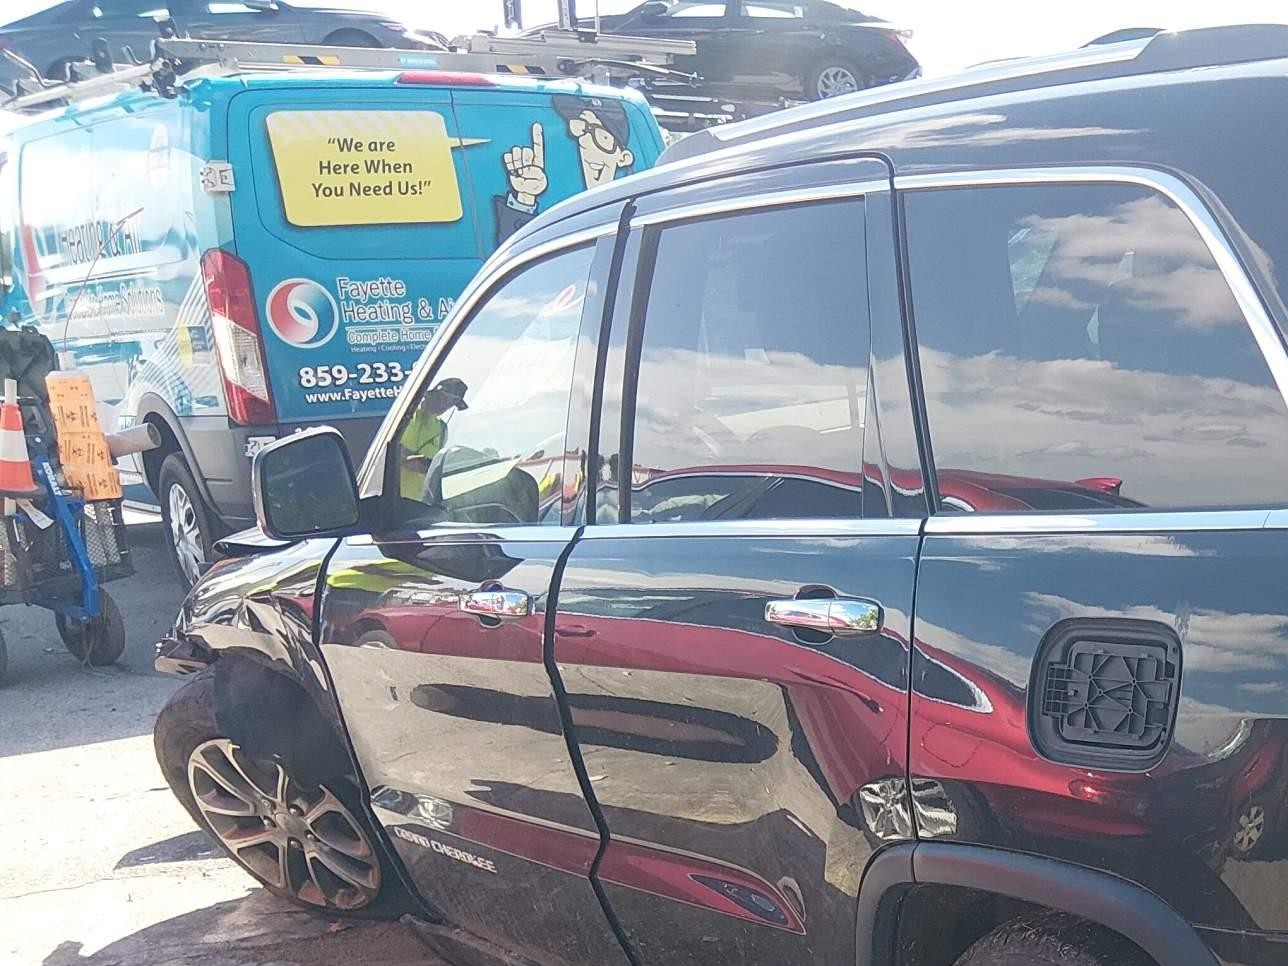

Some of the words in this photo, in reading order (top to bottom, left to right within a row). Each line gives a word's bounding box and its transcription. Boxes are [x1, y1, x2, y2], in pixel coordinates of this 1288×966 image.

[367, 140, 396, 152] are
[319, 160, 360, 175] Here
[364, 159, 412, 174] When
[312, 183, 344, 198] You
[349, 181, 393, 196] Need
[336, 277, 406, 303] Fayette
[341, 299, 414, 325] Heating
[418, 298, 433, 320] &
[347, 329, 399, 345] Complete
[400, 328, 432, 342] Home
